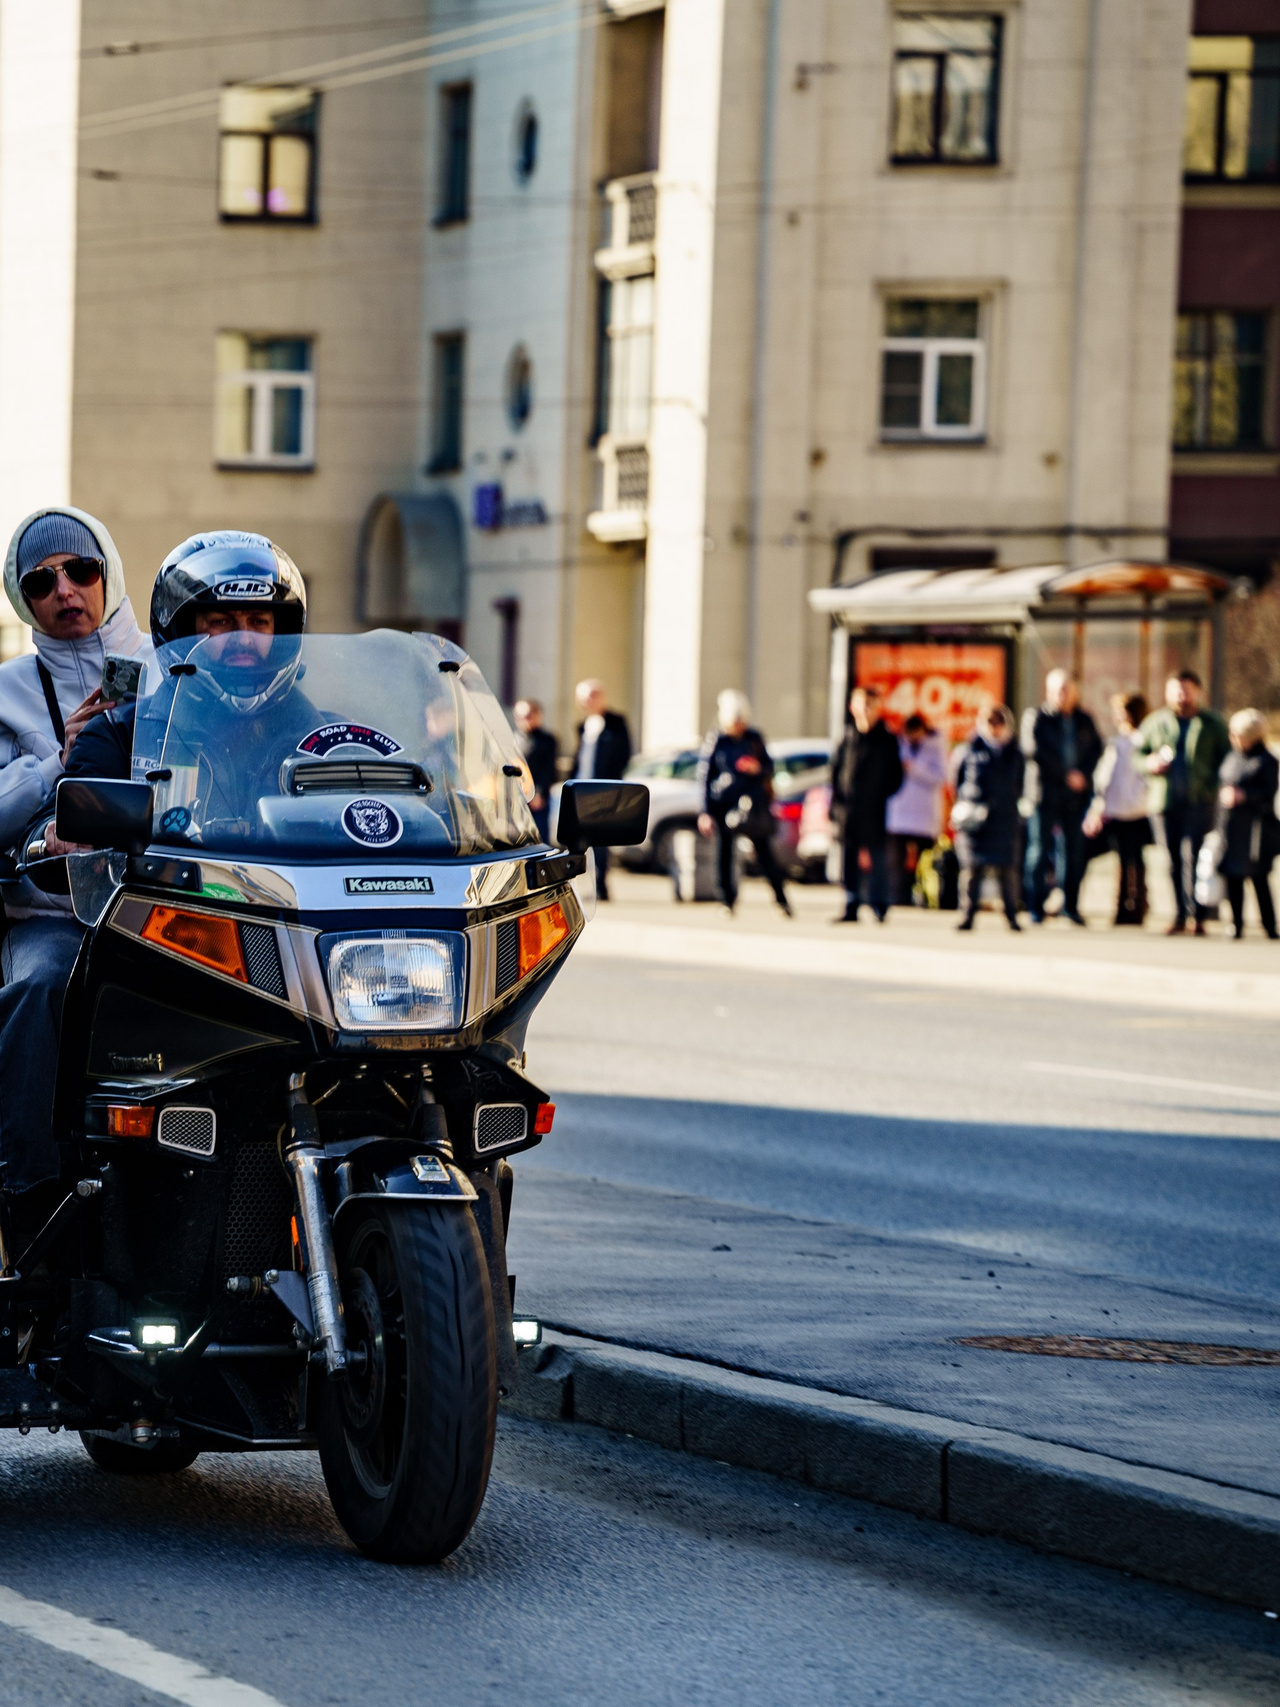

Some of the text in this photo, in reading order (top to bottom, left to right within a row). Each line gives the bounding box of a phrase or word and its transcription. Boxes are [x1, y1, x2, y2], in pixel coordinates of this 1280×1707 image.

[223, 582, 267, 593] HJC
[305, 726, 398, 751] ONE ROAD ONE CLUB
[349, 878, 431, 892] Kawasaki
